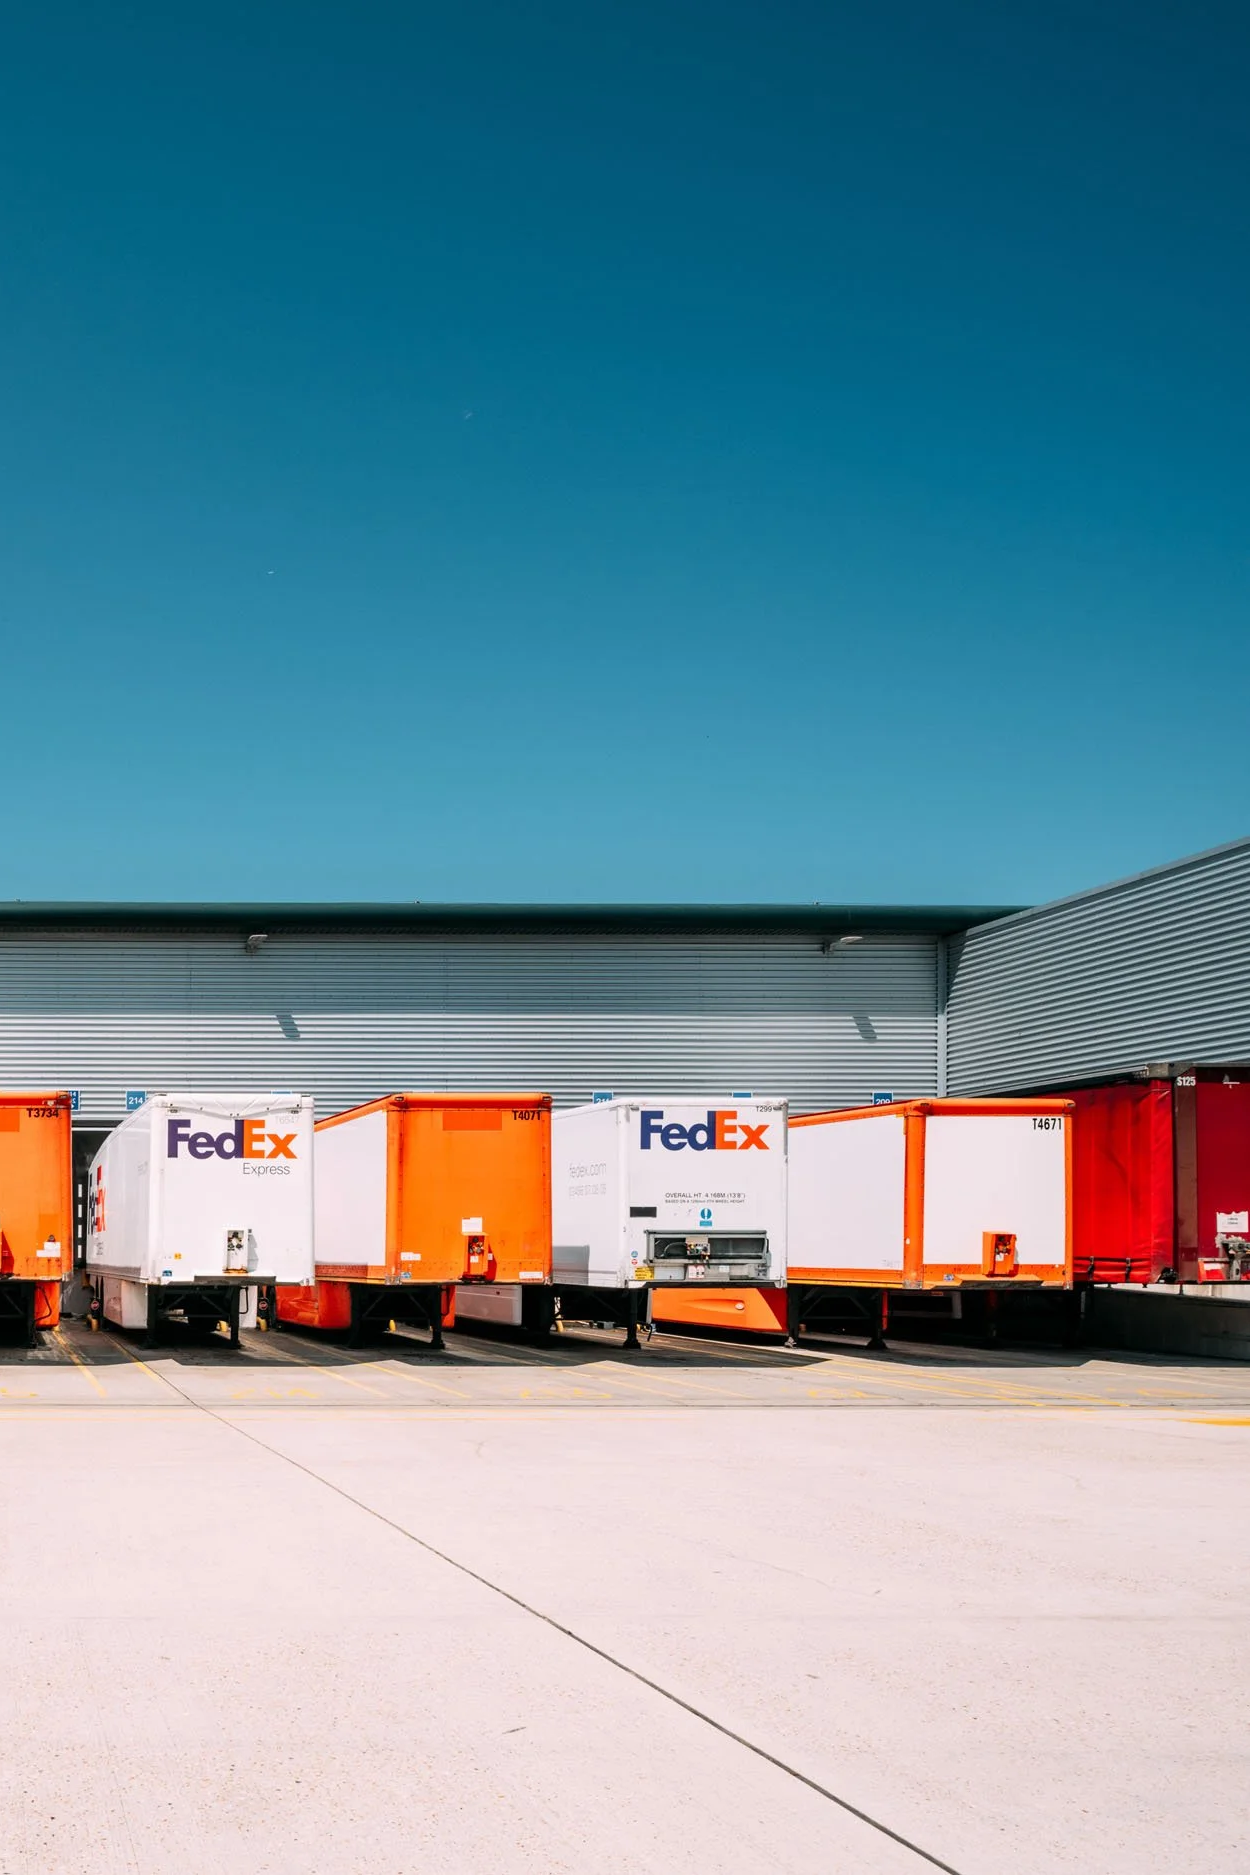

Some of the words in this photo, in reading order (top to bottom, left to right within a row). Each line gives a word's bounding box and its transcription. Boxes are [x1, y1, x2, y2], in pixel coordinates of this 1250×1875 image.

[1177, 1076, 1196, 1086] S125
[128, 1096, 143, 1105] 214
[26, 1108, 59, 1119] T3734
[512, 1110, 542, 1121] T4071
[1032, 1118, 1063, 1130] T4671
[640, 1110, 770, 1151] FedEx
[167, 1119, 298, 1160] FedEx
[243, 1163, 291, 1177] Express
